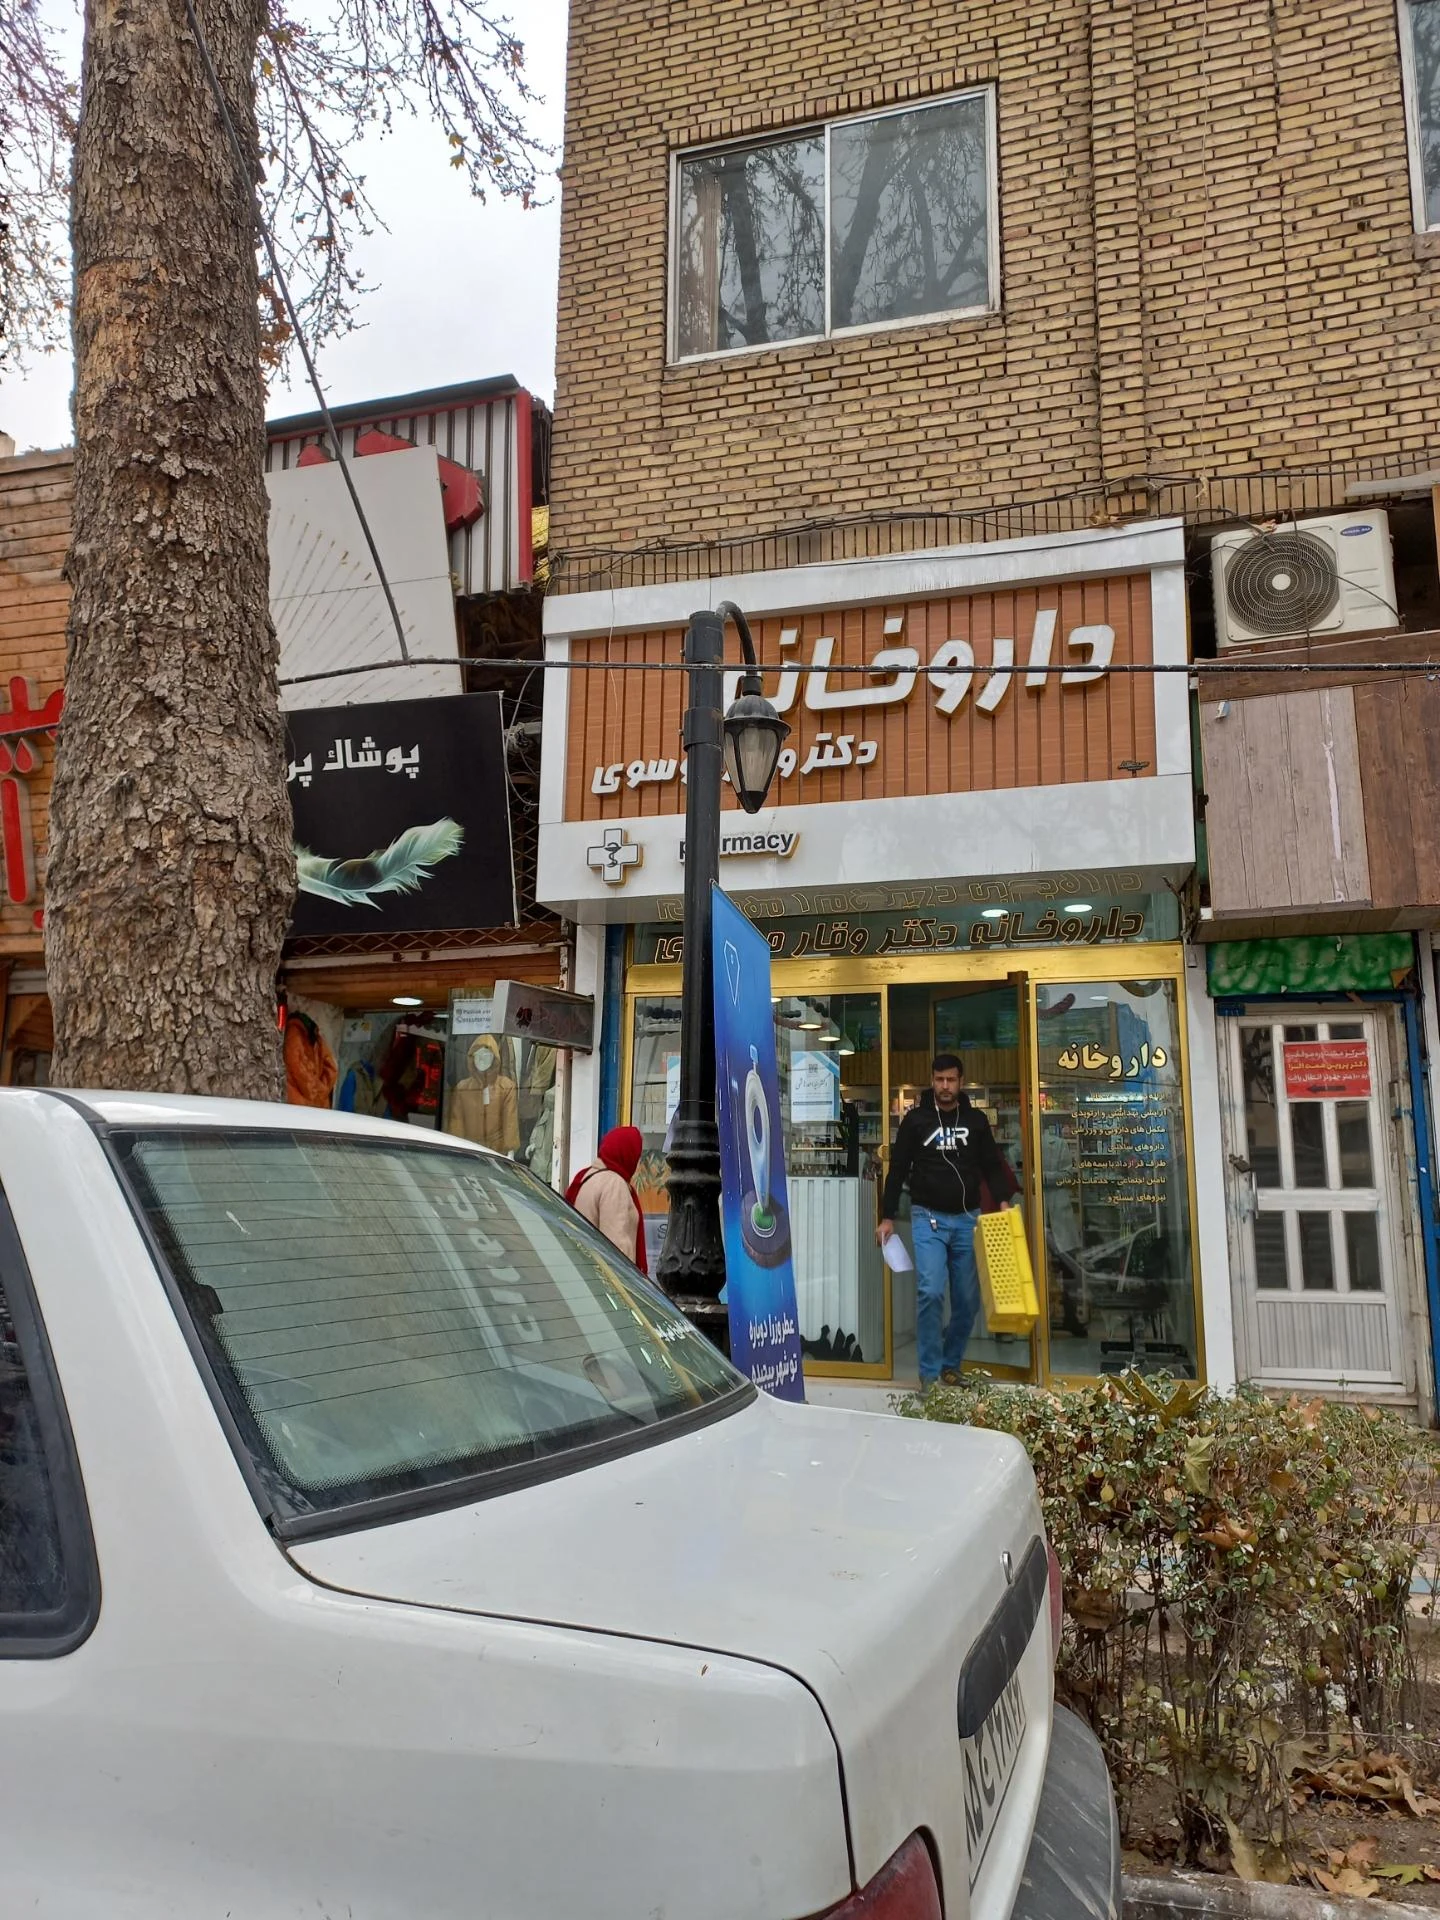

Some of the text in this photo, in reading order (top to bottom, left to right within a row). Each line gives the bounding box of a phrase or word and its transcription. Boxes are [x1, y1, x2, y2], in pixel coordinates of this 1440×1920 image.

[800, 733, 878, 775] دکتر
[591, 757, 688, 794] سوی
[679, 832, 794, 861] prmacy
[791, 921, 869, 959] وقار
[876, 918, 958, 955] دکتر
[969, 906, 1144, 946] داروخانه
[1058, 1042, 1167, 1077] داروخانه
[1130, 1125, 1145, 1134] های
[1145, 1126, 1166, 1136] مکمل
[1134, 1143, 1165, 1152] داروهای
[749, 1314, 768, 1349] دوباره
